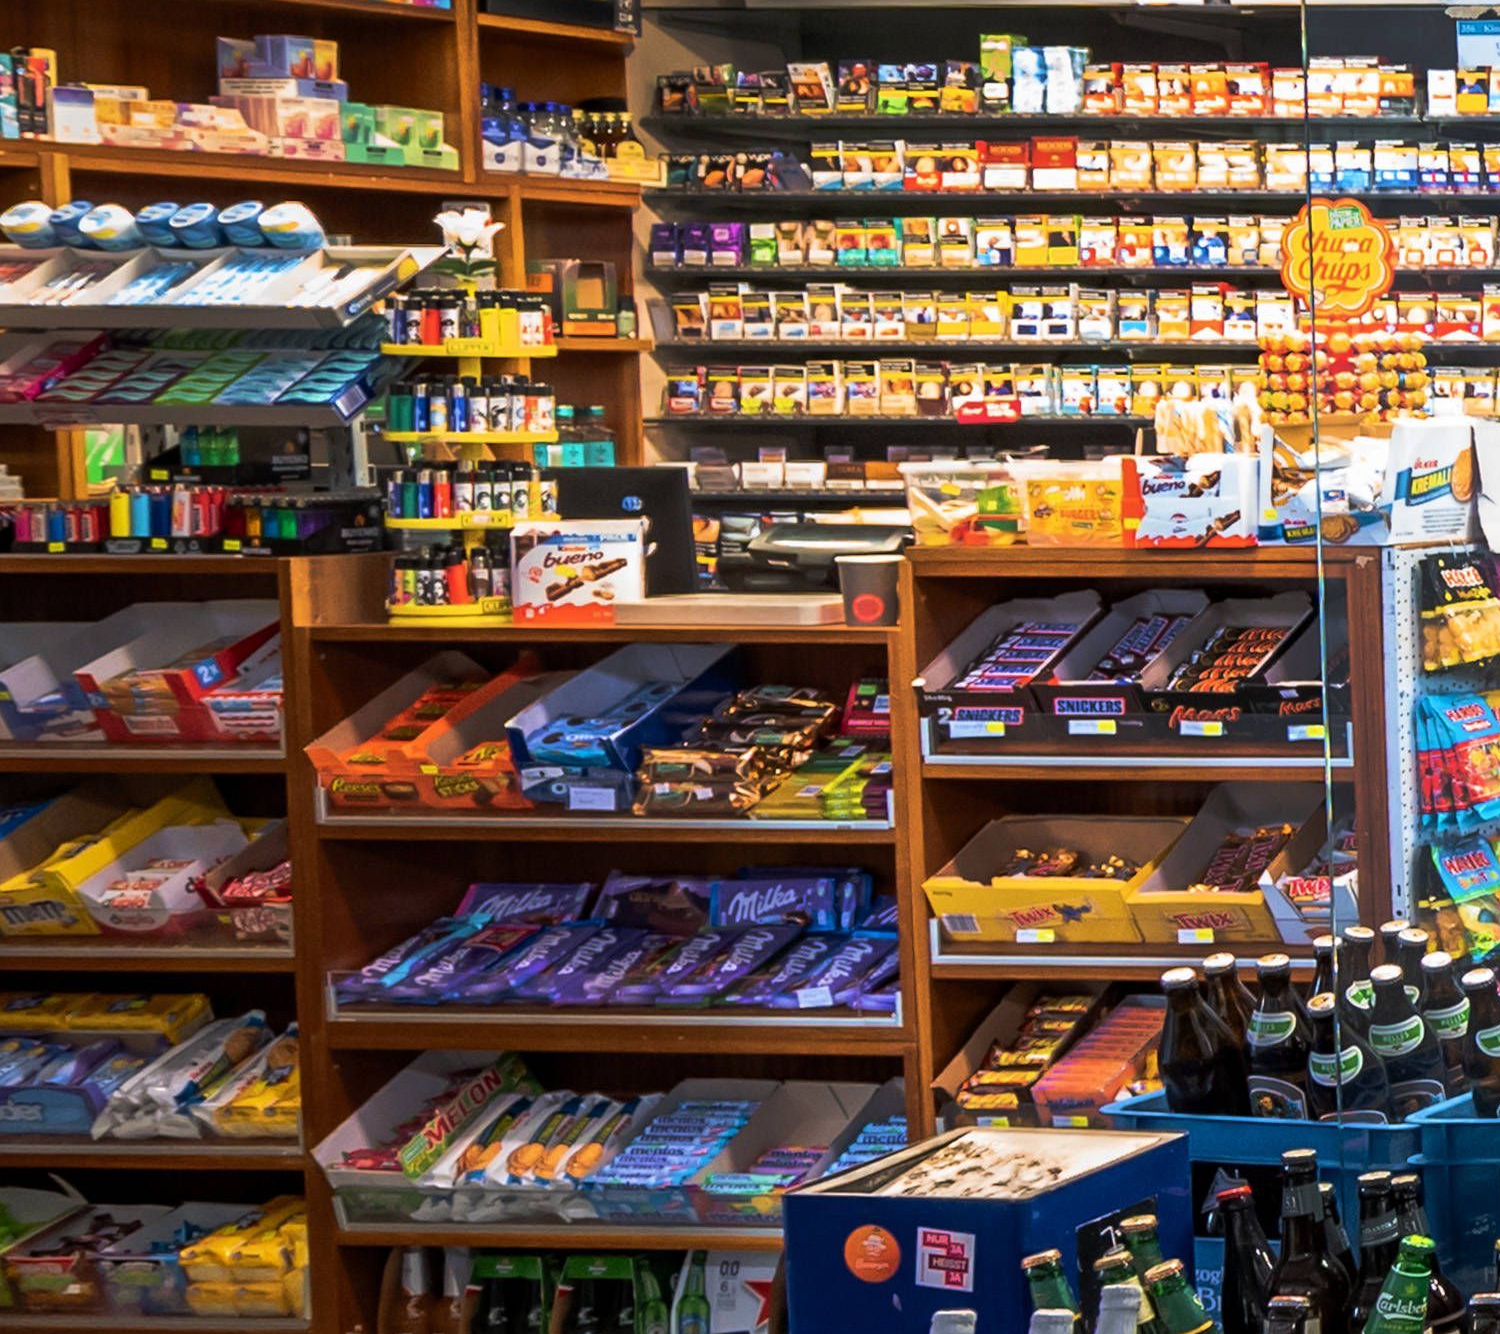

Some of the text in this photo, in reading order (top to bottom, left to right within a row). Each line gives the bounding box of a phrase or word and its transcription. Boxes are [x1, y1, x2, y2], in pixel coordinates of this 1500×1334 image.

[543, 549, 605, 569] bueno
[957, 707, 1022, 724] SNICKERS
[1056, 698, 1124, 715] SNICKERS
[1446, 701, 1485, 720] HARIBO
[480, 887, 556, 923] Milka
[727, 882, 799, 924] Milka
[1008, 905, 1056, 929] Twix
[1174, 910, 1232, 930] Twix
[721, 928, 776, 976] Milka
[418, 1066, 504, 1151] MELON
[924, 1233, 951, 1247] NUR
[949, 1243, 965, 1256] JA
[931, 1256, 969, 1270] HEISST
[947, 1273, 963, 1286] JA
